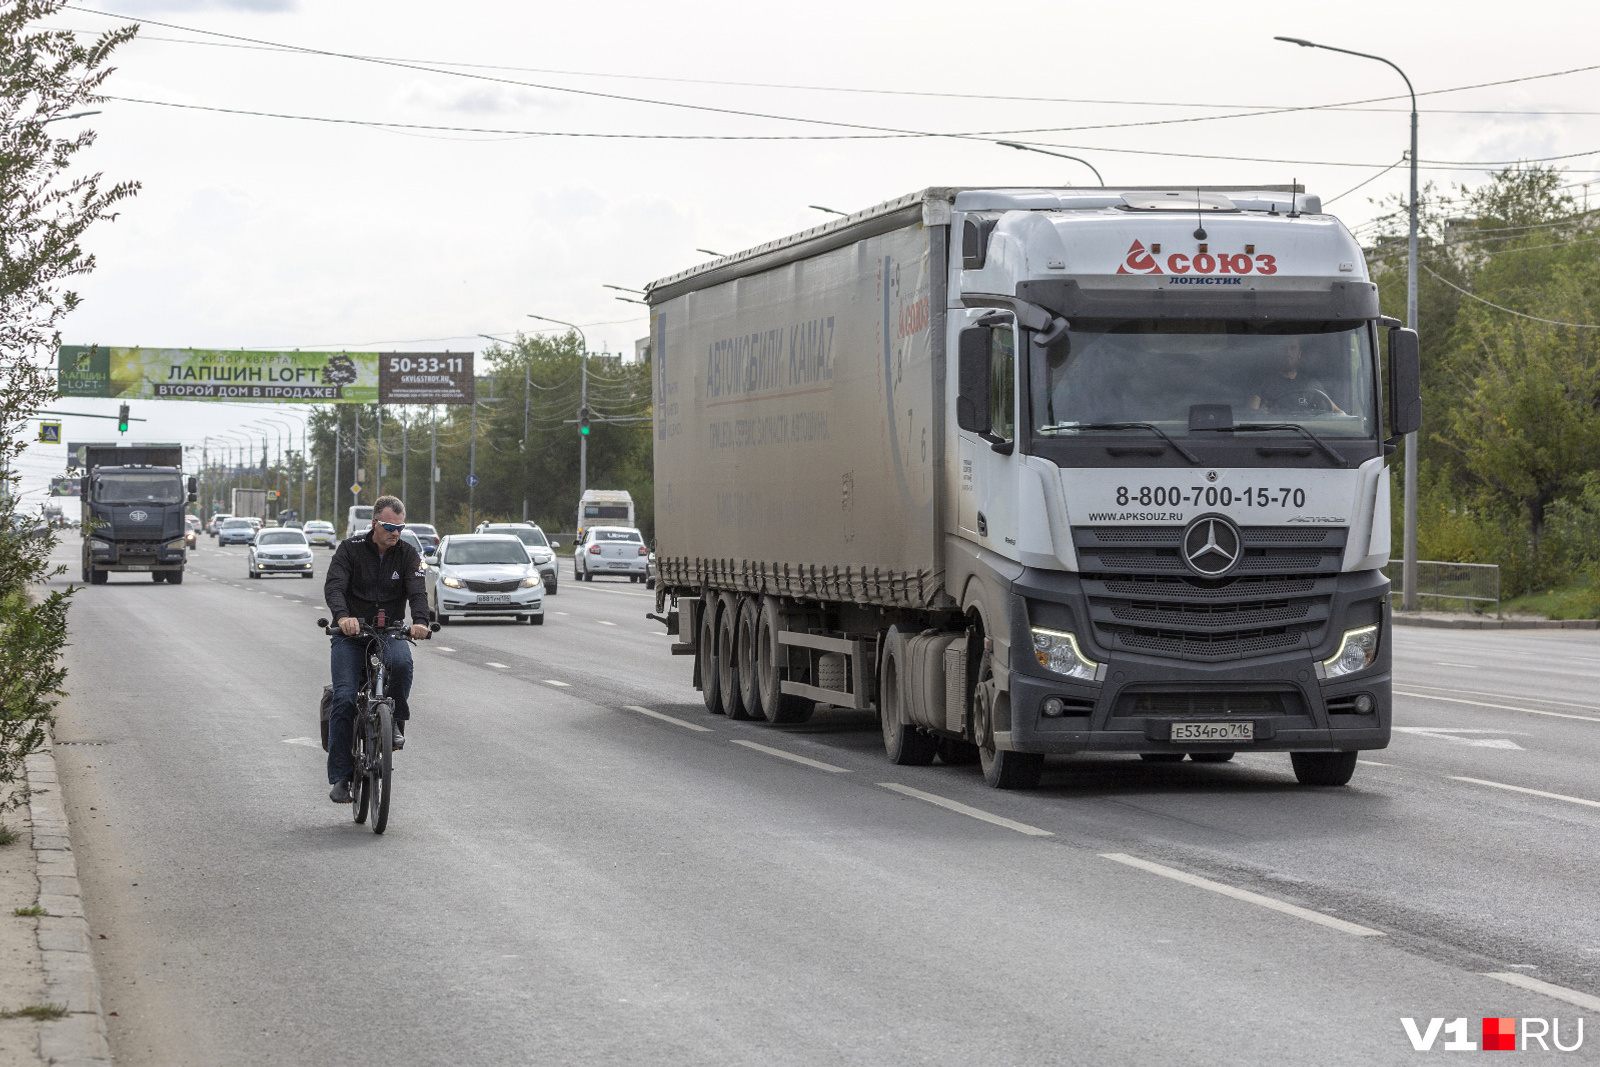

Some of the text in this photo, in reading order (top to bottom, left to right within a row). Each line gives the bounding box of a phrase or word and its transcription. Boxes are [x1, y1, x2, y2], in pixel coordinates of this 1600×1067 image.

[199, 355, 297, 364] ЖИЛОЙ КВАРТАЛ
[389, 357, 463, 373] 50-33-11
[706, 327, 784, 399] АВТОМОБИЛИ
[168, 366, 320, 382] ЛАПШИН LOFT
[159, 383, 337, 398] ВТОРОЙ ДОМ В ПРОДАЖЕ!
[1116, 486, 1306, 508] 8-800-700-15-70
[1088, 512, 1183, 521] WWW.APKSOUZ.RU
